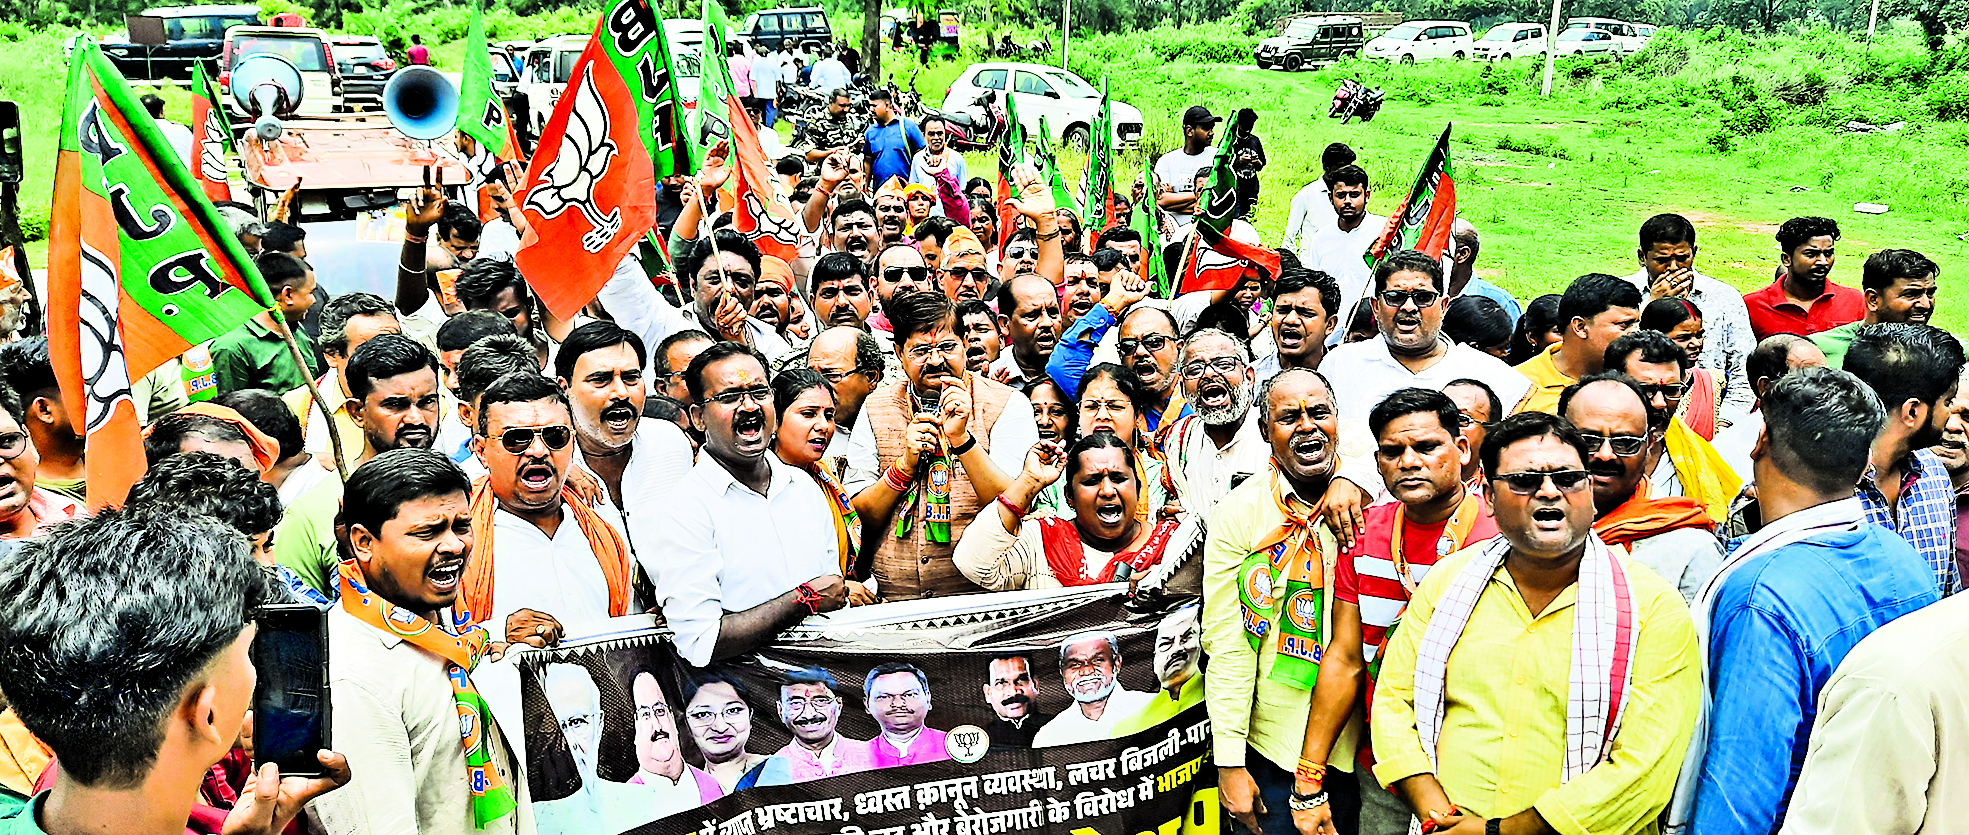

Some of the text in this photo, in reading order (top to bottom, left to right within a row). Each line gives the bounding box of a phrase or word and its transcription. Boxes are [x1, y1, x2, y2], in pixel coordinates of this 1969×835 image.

[1066, 758, 1118, 786] लचर
[1046, 796, 1071, 823] के
[1073, 787, 1136, 820] विरोध
[1137, 774, 1155, 801] में
